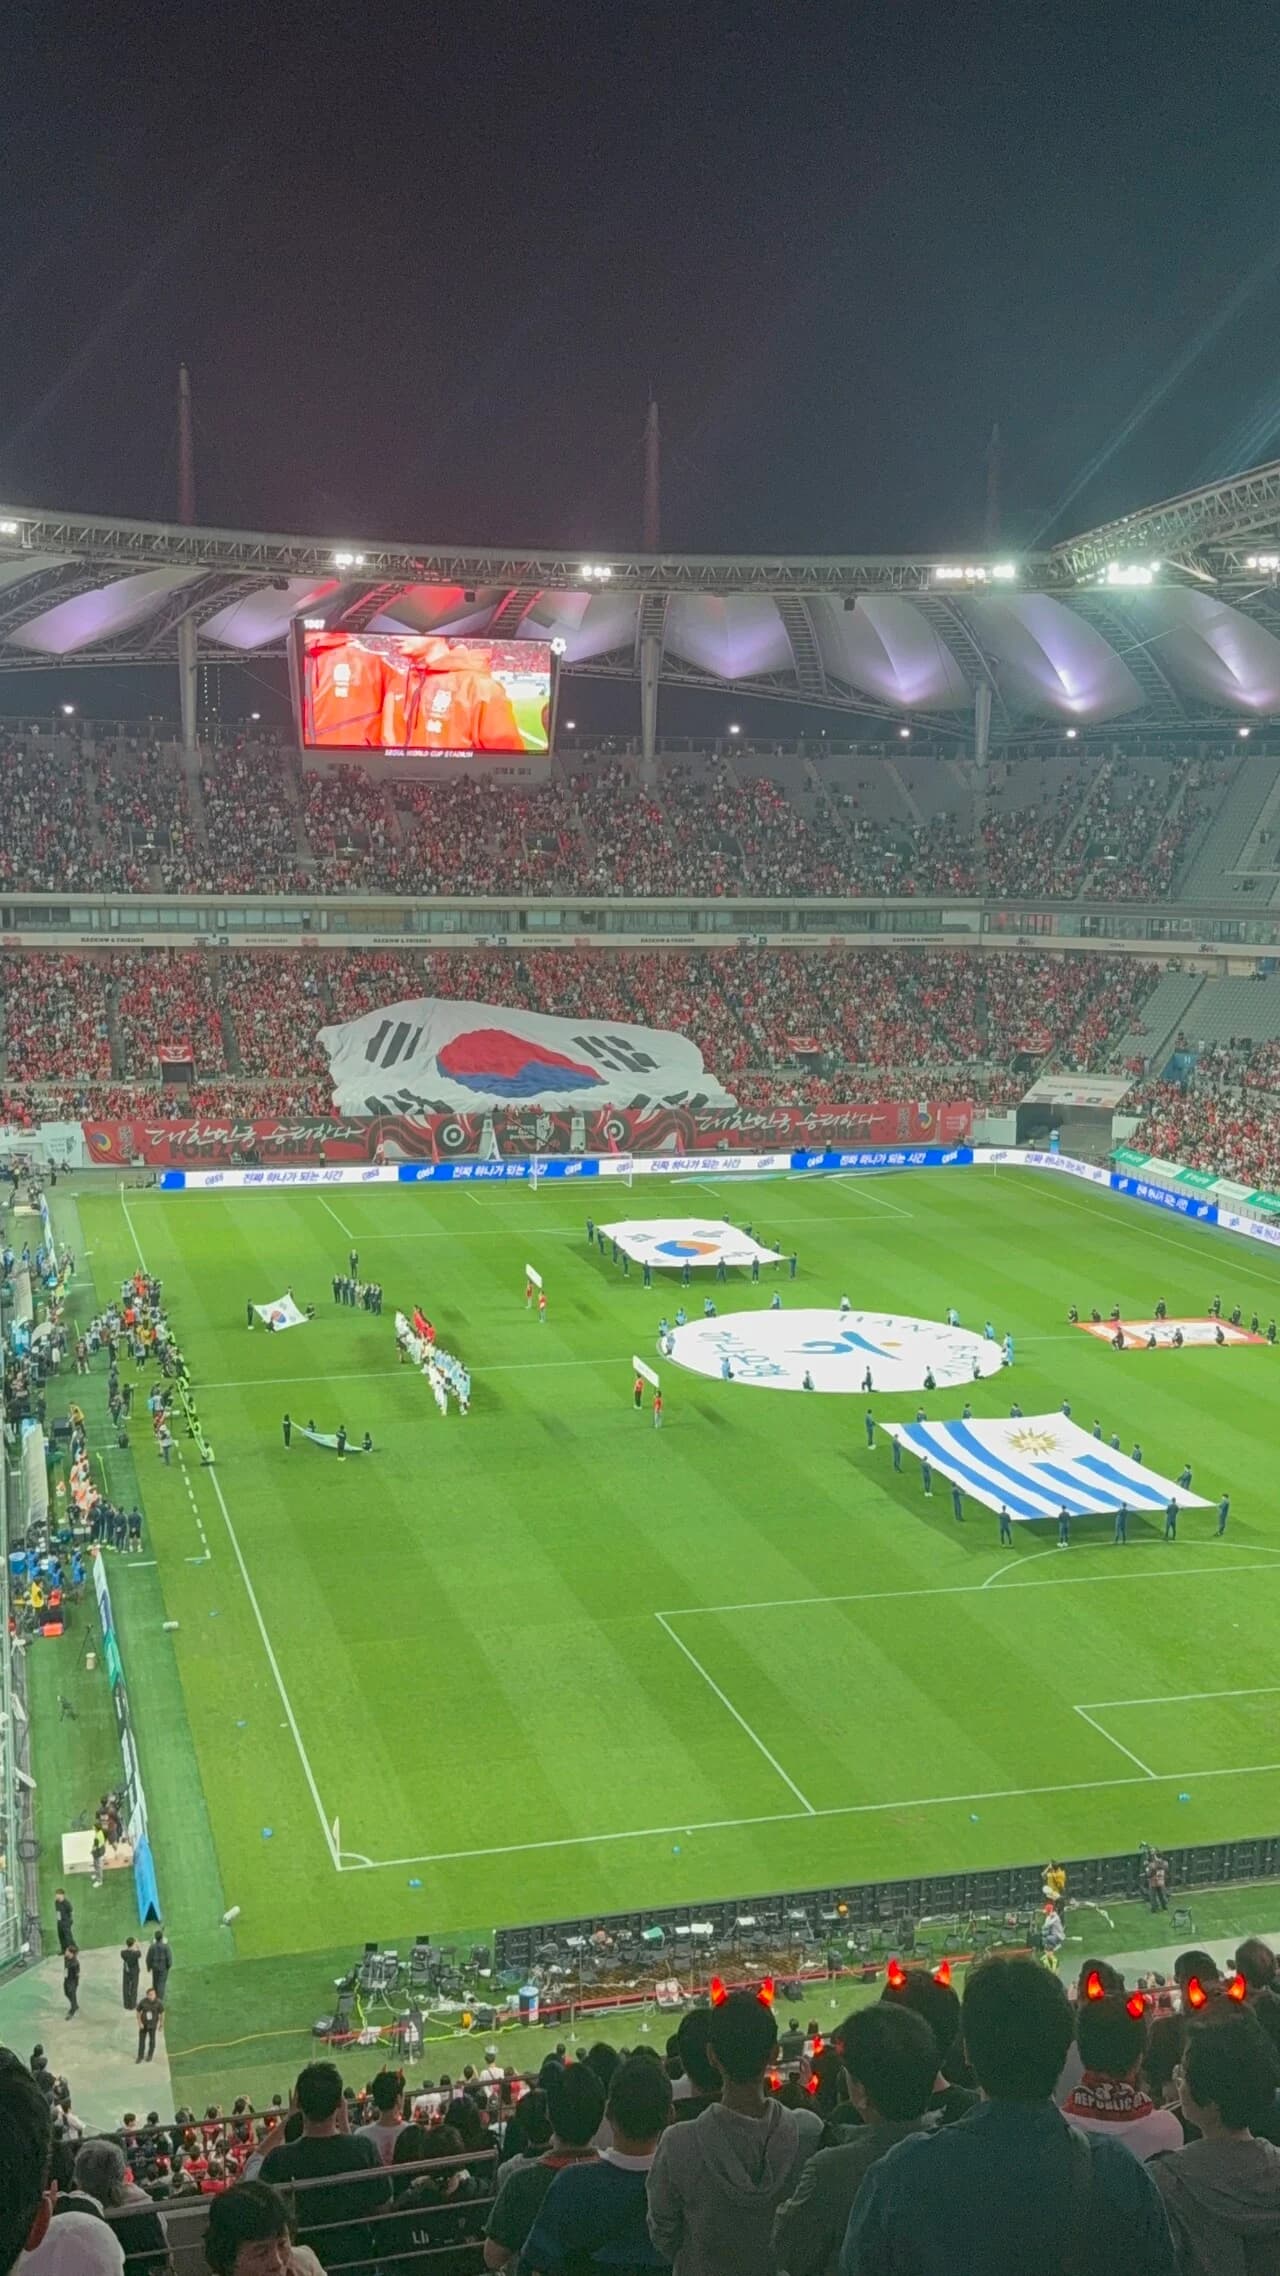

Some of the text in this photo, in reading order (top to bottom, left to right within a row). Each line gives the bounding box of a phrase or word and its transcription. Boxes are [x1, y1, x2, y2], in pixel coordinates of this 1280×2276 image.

[430, 750, 443, 758] CUP
[444, 750, 473, 758] STADIUM
[694, 1107, 791, 1134] 대한민국
[145, 1120, 256, 1148] 대한민국
[1073, 2092, 1132, 2112] REPUBLIC
